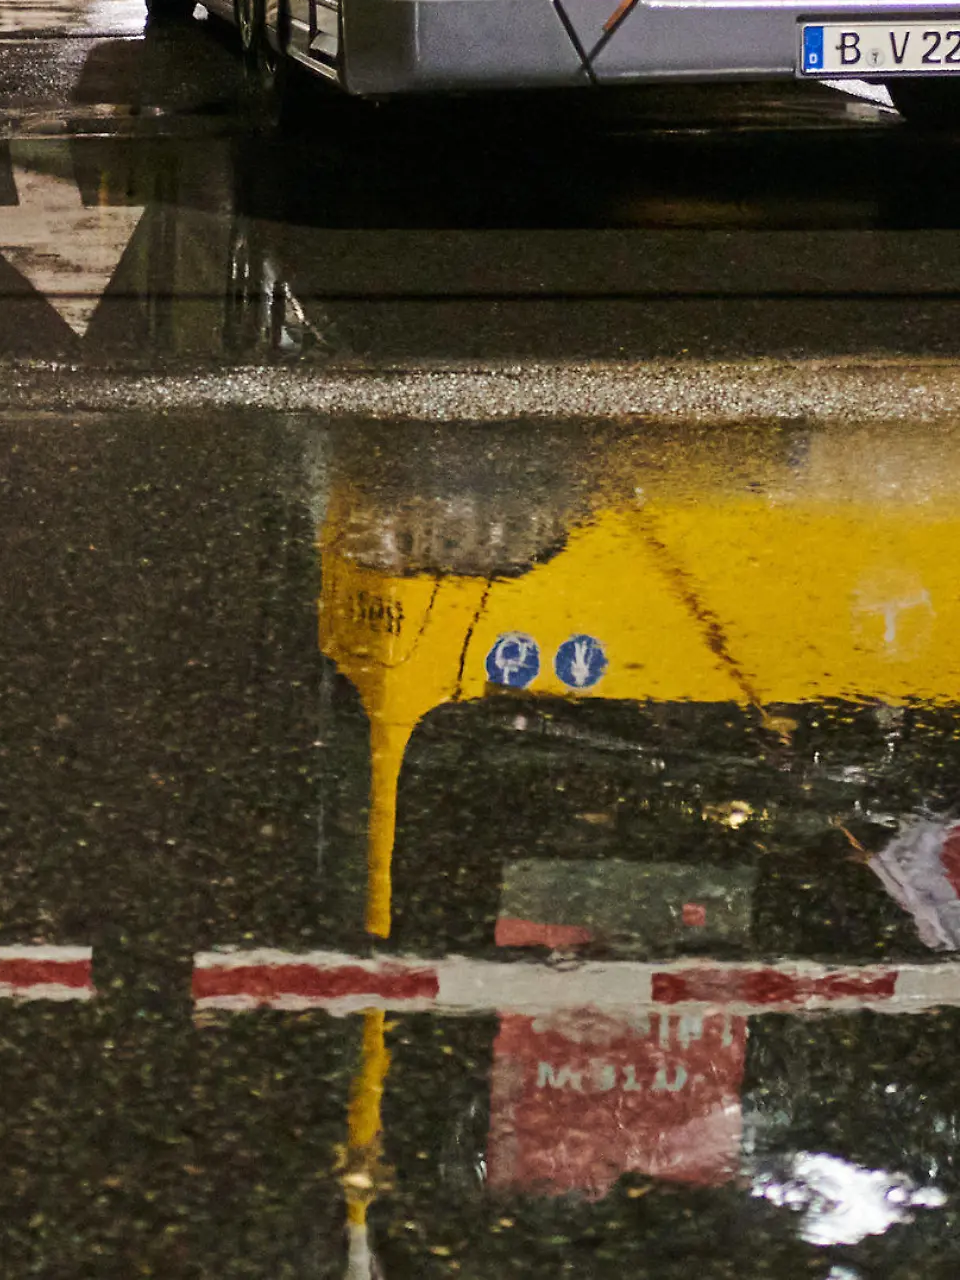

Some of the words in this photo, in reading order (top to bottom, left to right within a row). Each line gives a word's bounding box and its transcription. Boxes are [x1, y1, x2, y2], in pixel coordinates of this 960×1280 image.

[840, 32, 861, 65] B
[890, 31, 910, 64] V
[921, 31, 960, 64] 22
